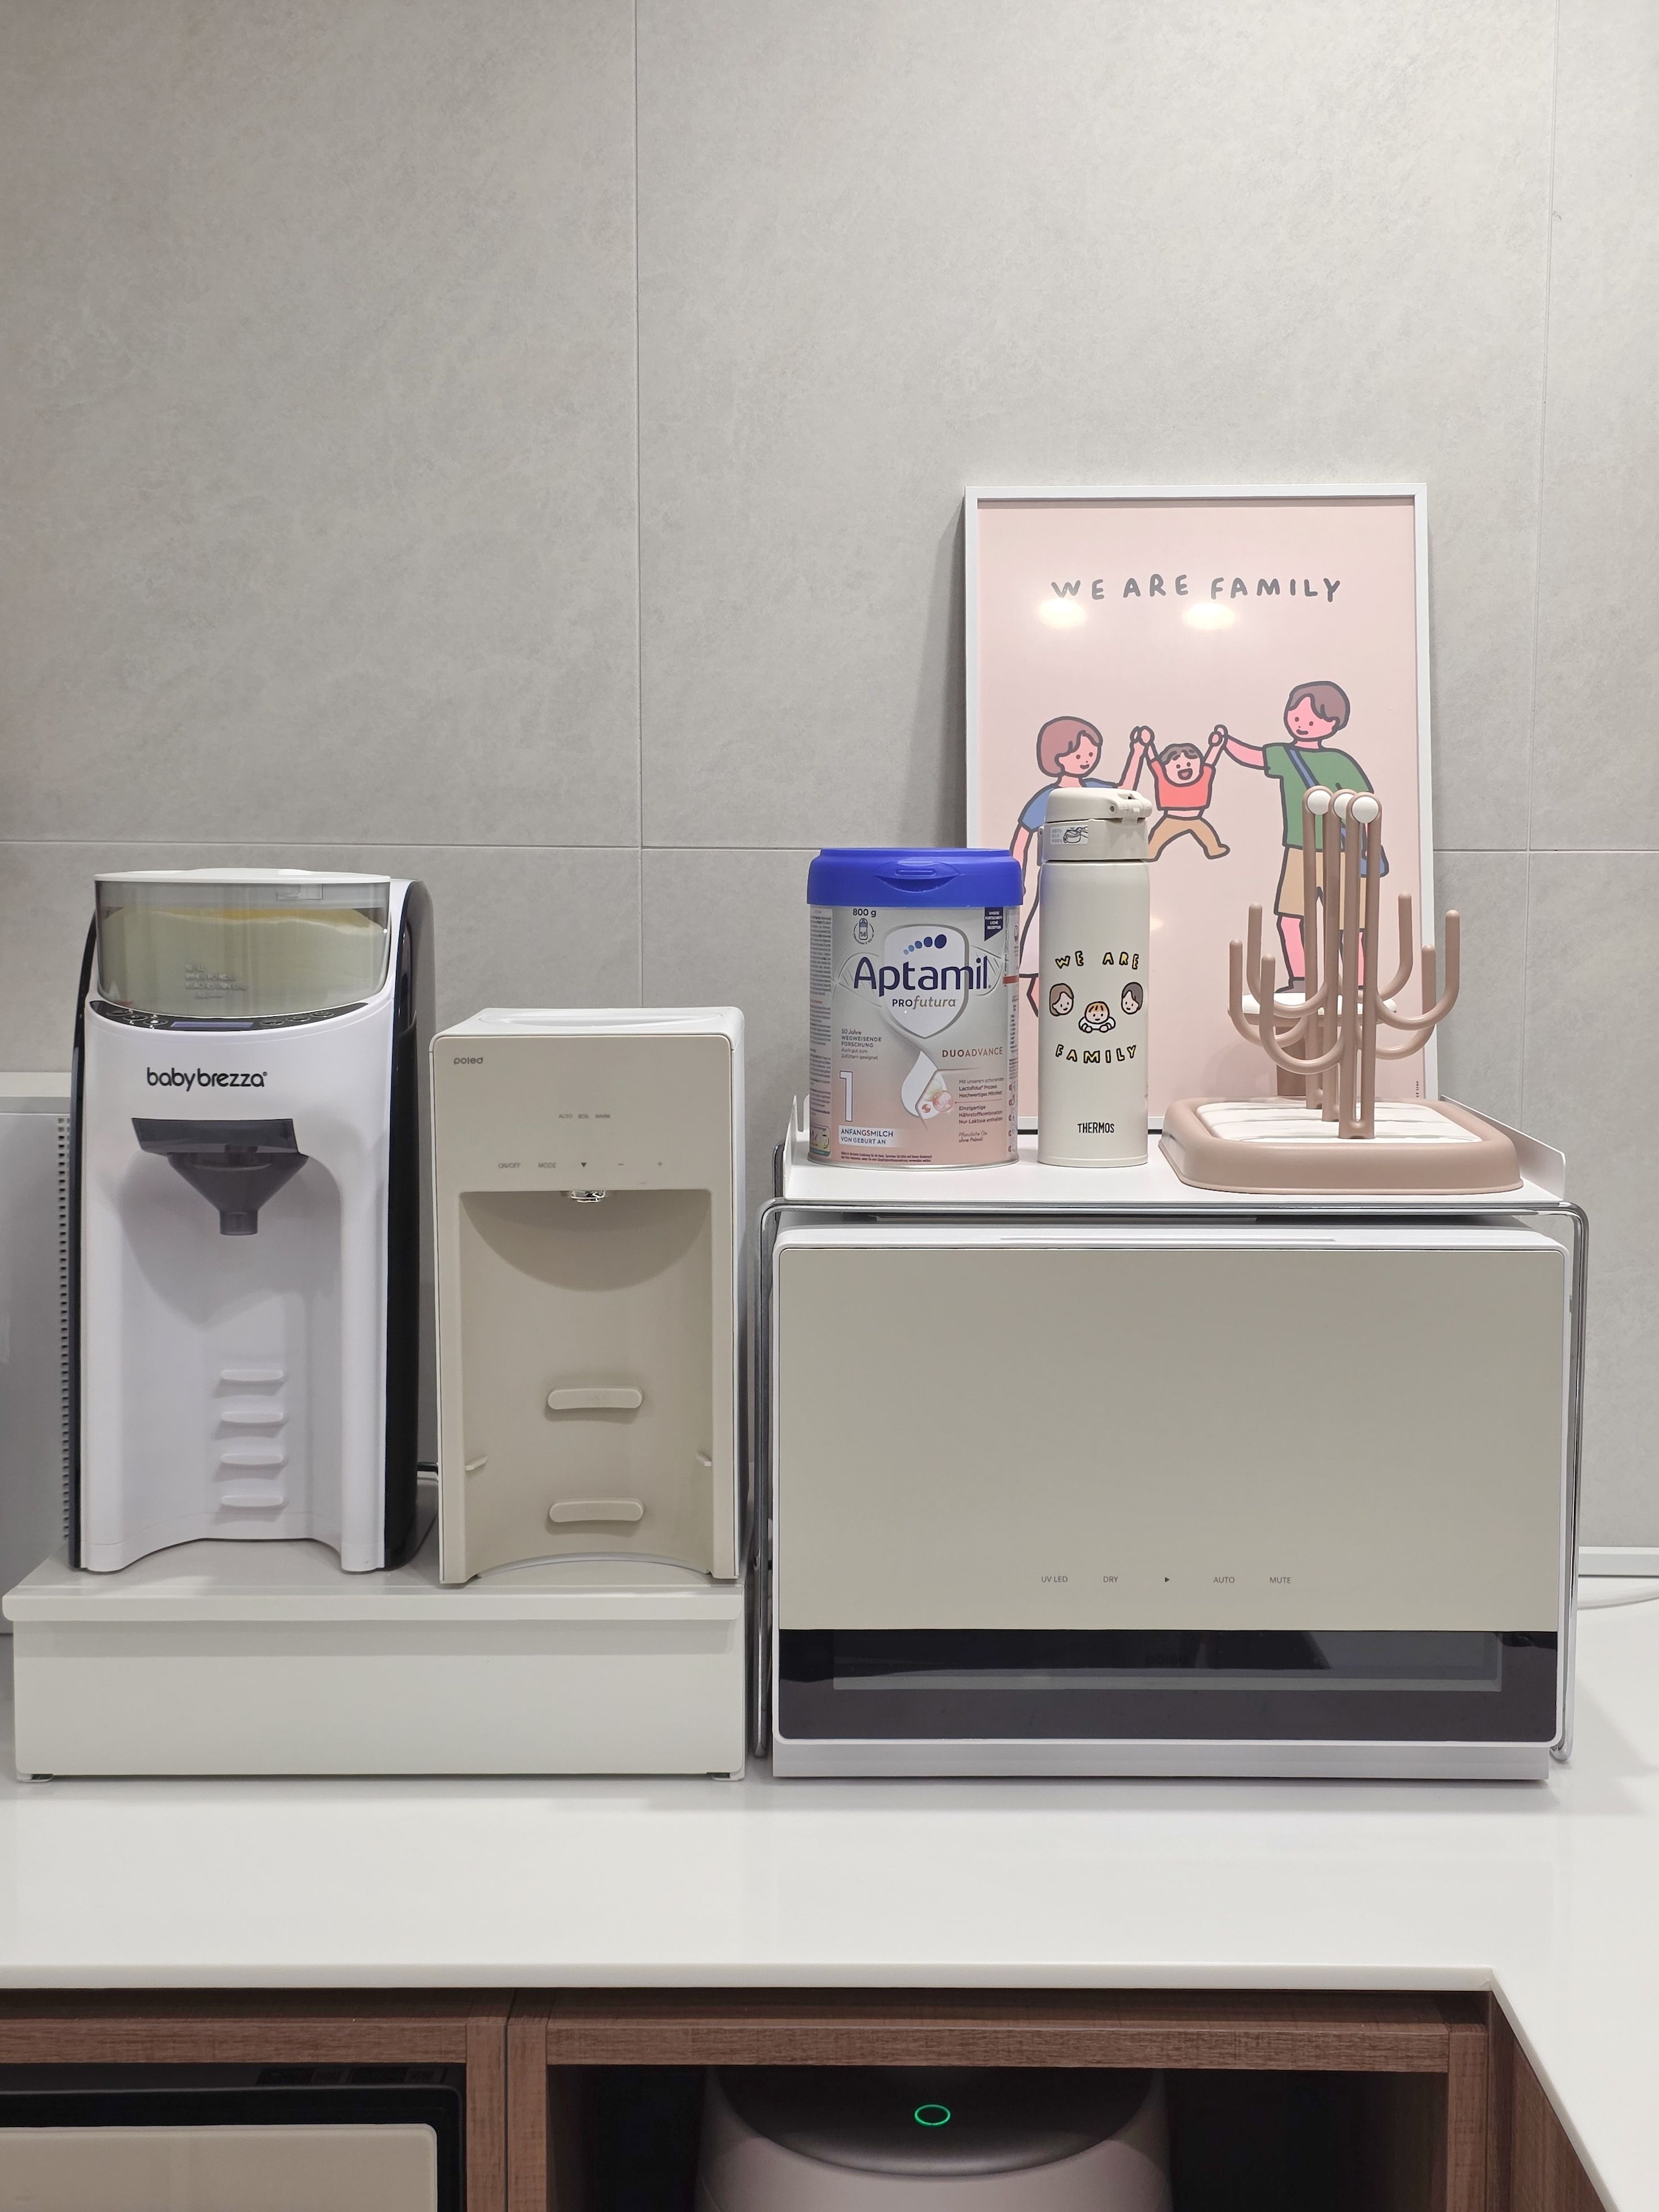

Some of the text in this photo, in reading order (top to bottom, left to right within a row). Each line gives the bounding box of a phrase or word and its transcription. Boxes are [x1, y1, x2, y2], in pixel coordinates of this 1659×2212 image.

[1051, 574, 1341, 603] WE ARE FAMILY
[1055, 951, 1139, 970] WE ARE
[853, 955, 988, 997] Aptamil
[892, 995, 956, 1010] PROfutura
[942, 1047, 1003, 1058] DUOADVANCE
[1055, 1044, 1137, 1064] FAMILY
[840, 1071, 853, 1122] 1
[841, 1128, 894, 1137] ANFANGSMILCH
[1077, 1122, 1115, 1134] THERMOS
